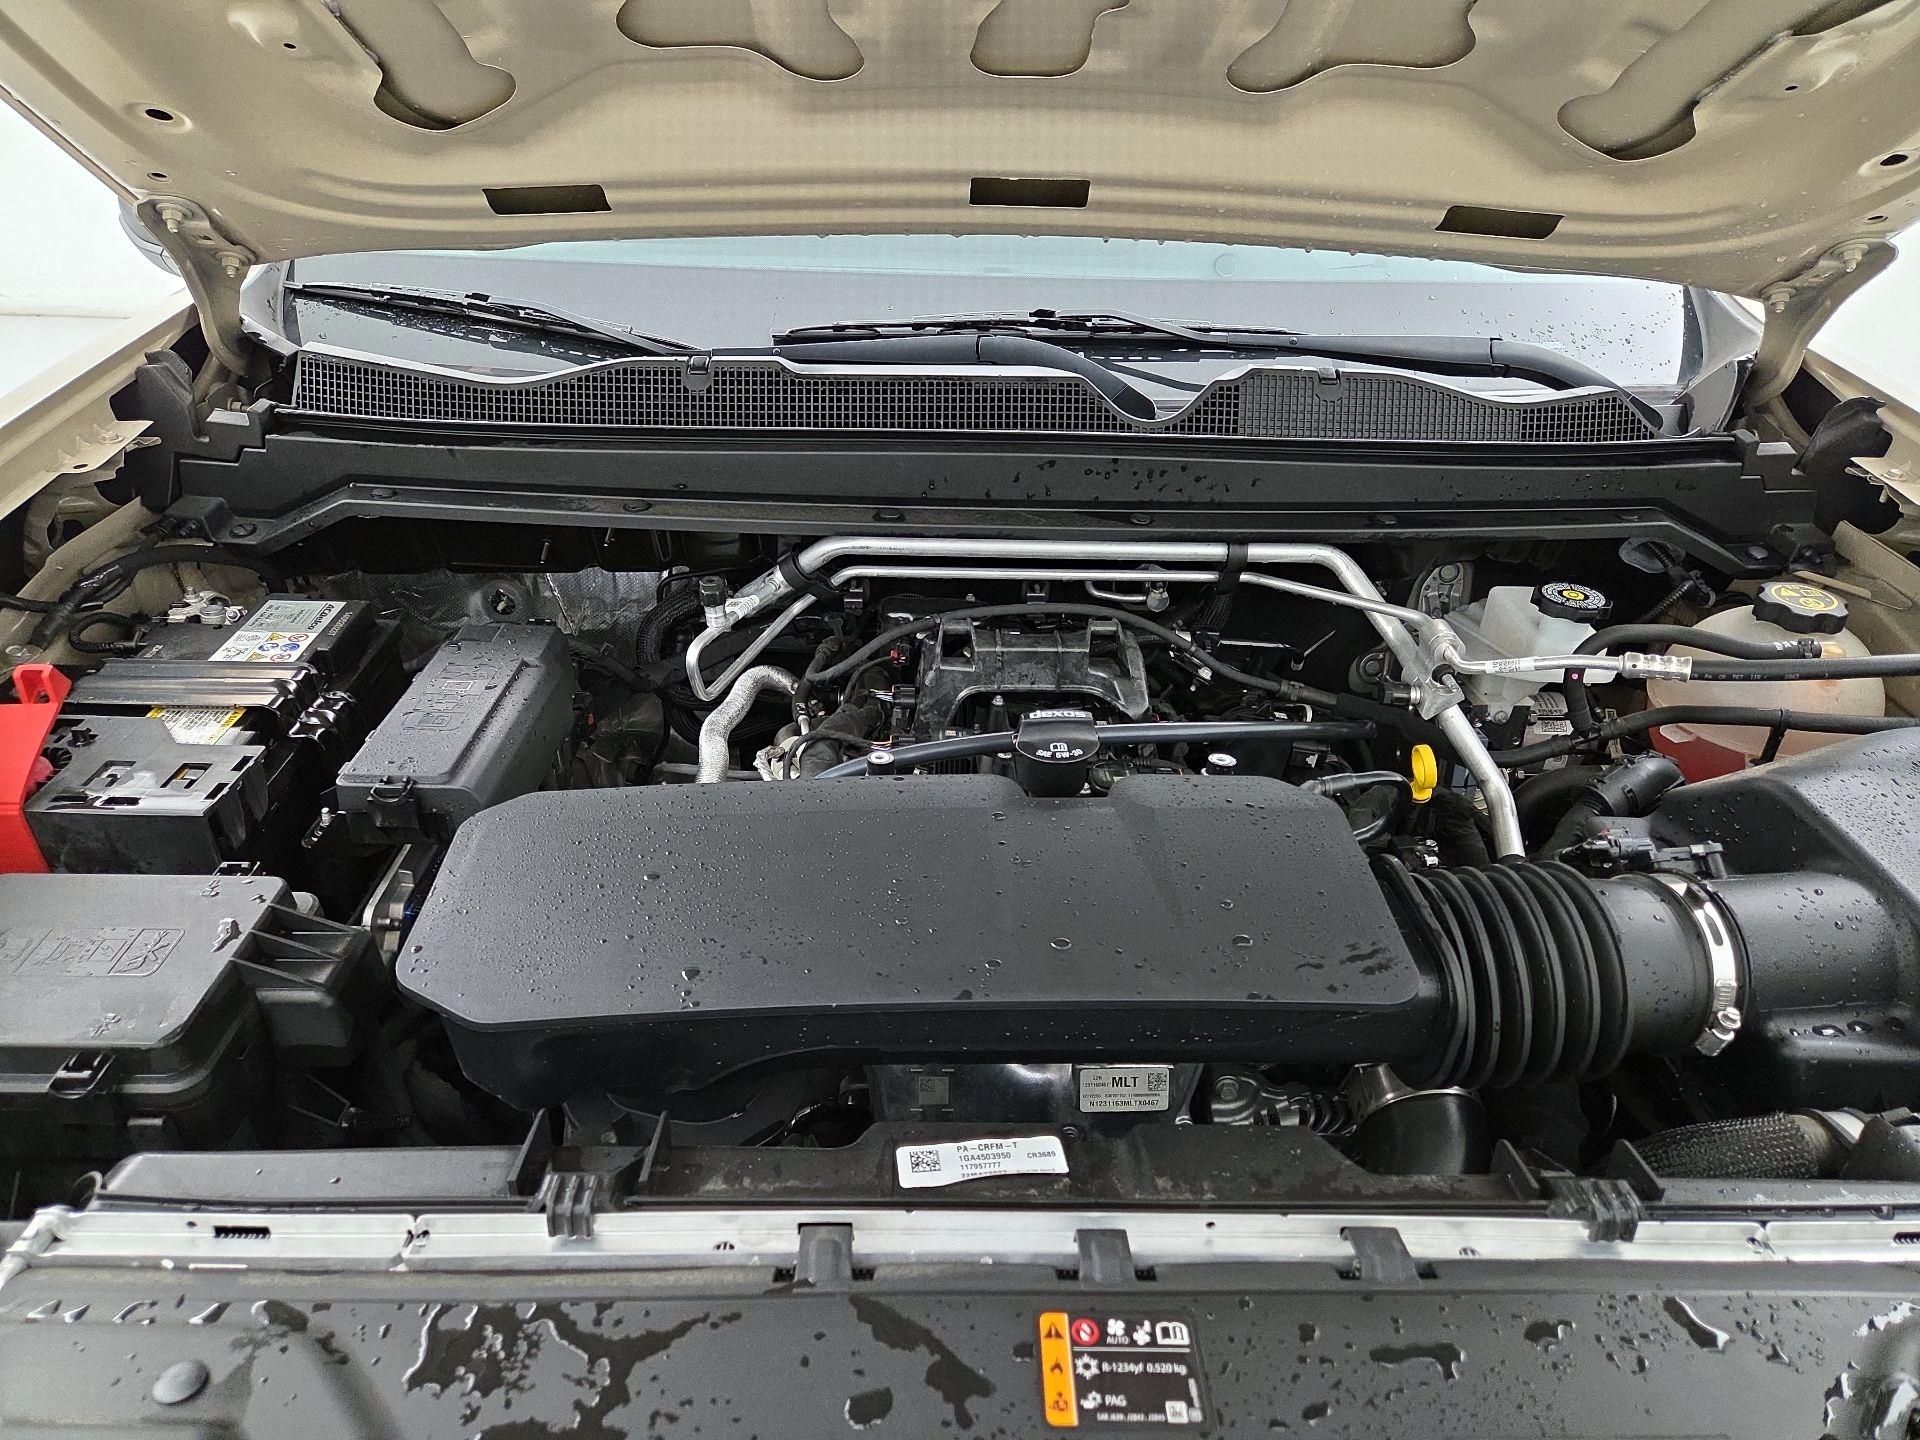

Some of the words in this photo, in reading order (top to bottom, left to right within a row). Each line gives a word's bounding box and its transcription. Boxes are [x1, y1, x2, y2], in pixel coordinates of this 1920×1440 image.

[308, 603, 335, 630] ACDelco
[1029, 710, 1086, 719] dexos
[1036, 749, 1052, 758] SAE
[1111, 1076, 1139, 1088] MLT
[959, 1152, 1012, 1163] 1GA4503950
[1026, 1150, 1057, 1159] CR3689
[960, 1161, 1002, 1171] 117957777
[1106, 1335, 1130, 1345] AUTO
[1101, 1361, 1144, 1375] R-1234yf
[1146, 1362, 1172, 1374] 0.520
[1173, 1362, 1188, 1376] kg
[1104, 1394, 1127, 1407] PAG
